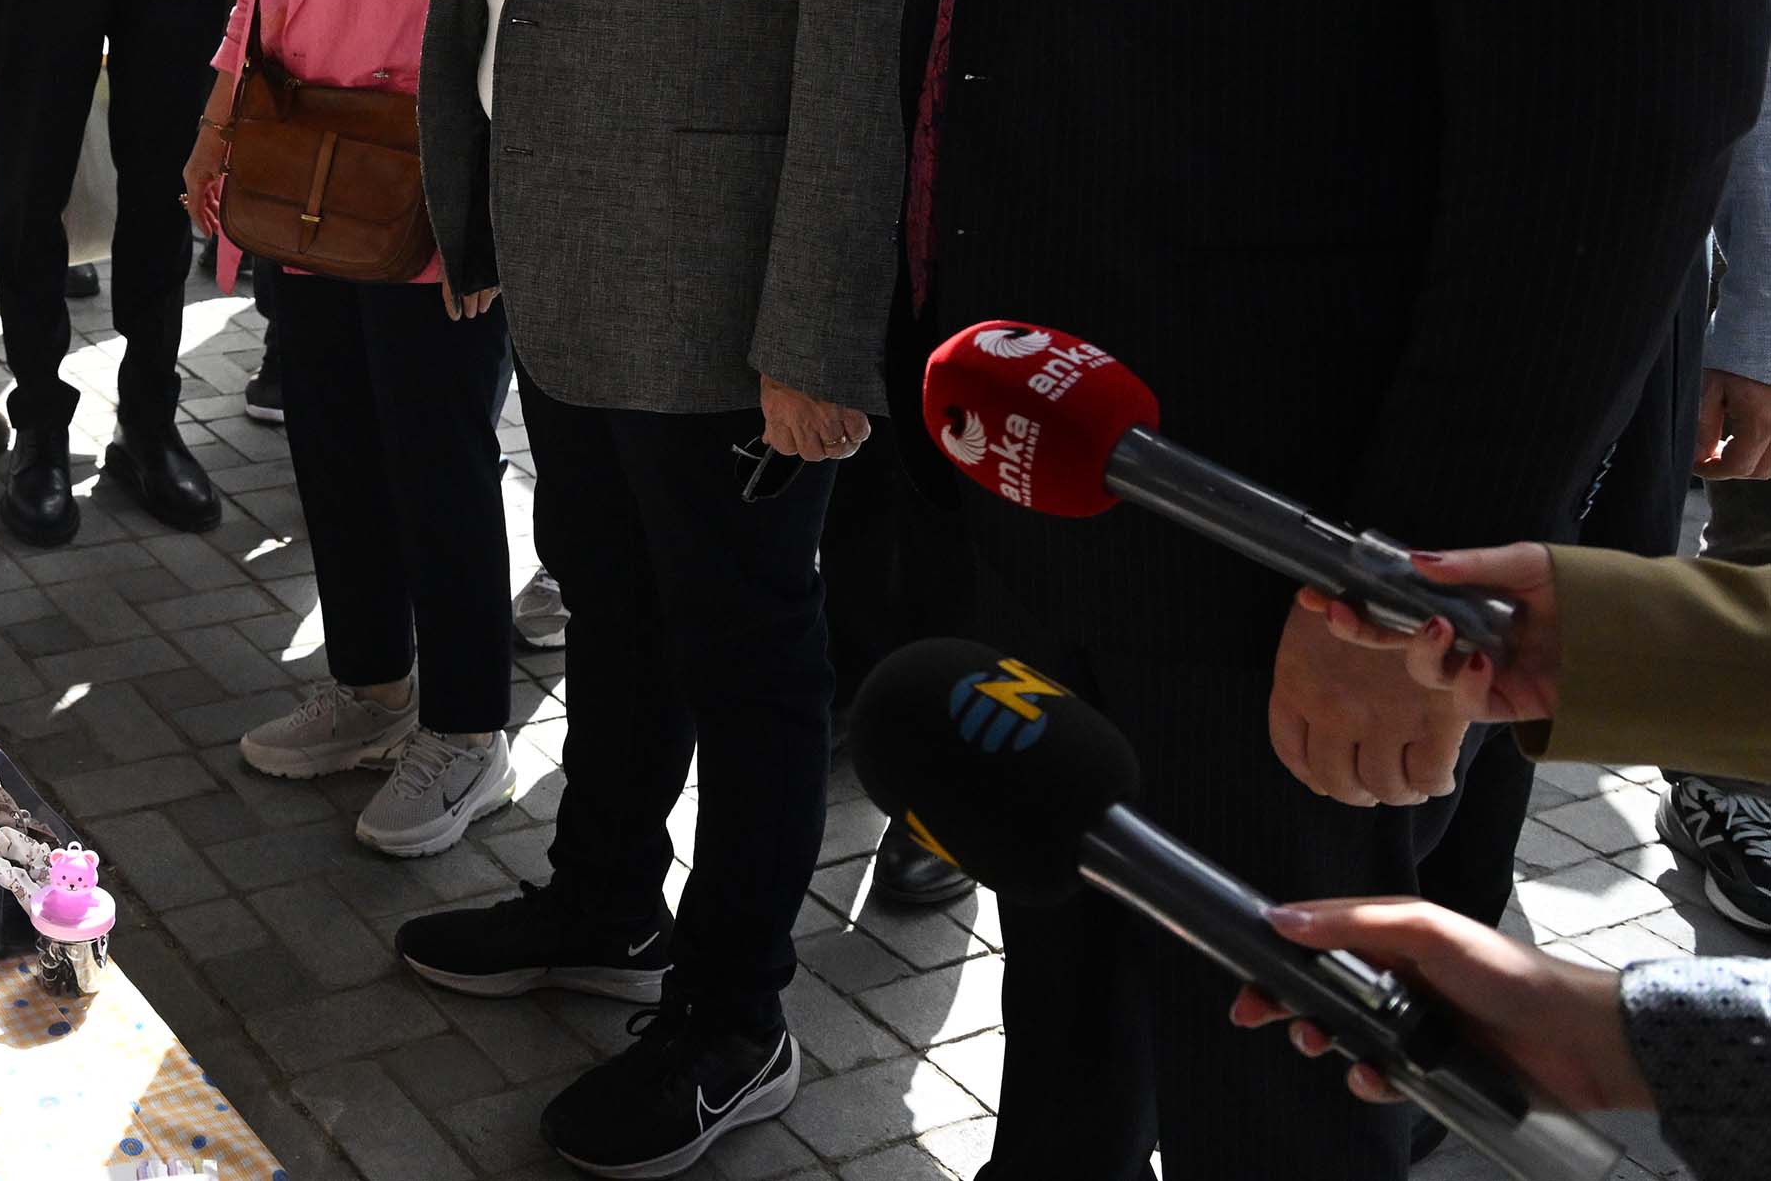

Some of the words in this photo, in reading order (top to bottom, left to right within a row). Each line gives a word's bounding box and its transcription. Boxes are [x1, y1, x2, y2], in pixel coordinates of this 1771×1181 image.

[1028, 343, 1108, 395] anka
[988, 414, 1030, 503] anka
[1023, 421, 1041, 470] AJANSI
